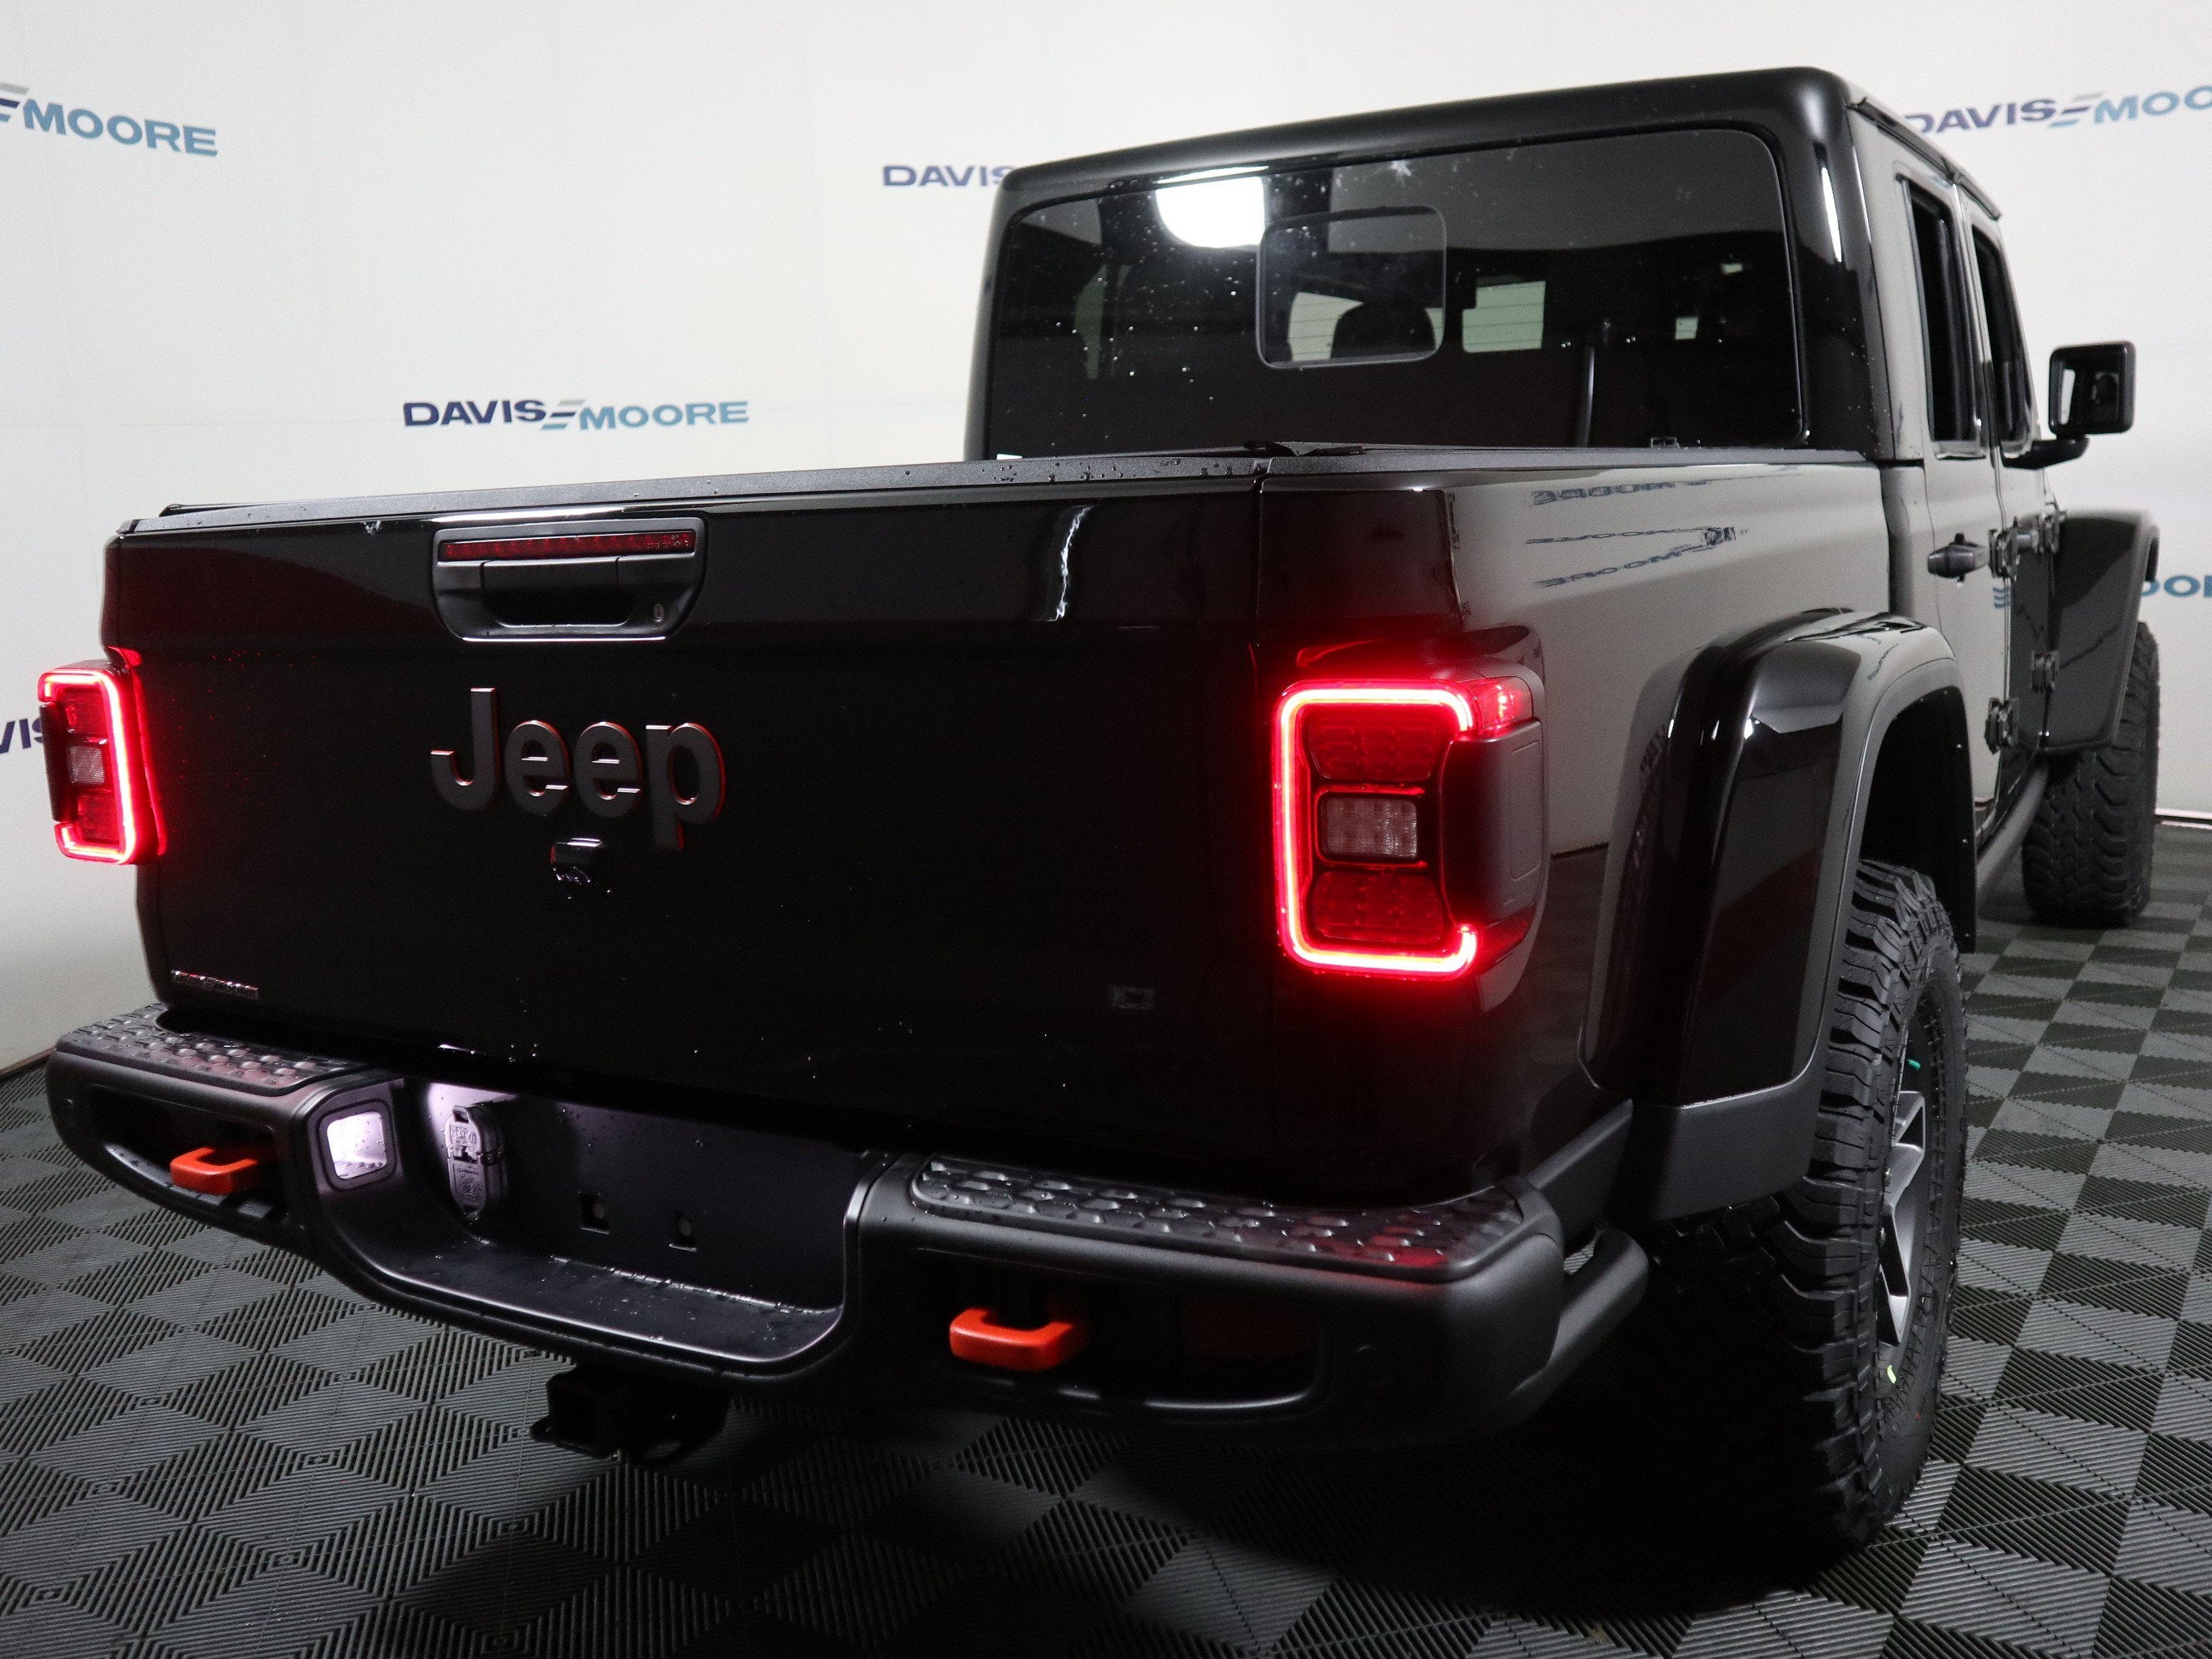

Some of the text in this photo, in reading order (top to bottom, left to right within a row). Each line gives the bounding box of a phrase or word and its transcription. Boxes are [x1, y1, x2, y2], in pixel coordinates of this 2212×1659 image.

[22, 98, 218, 157] MOORE
[402, 399, 750, 431] DAVIS MOORE
[431, 687, 727, 850] Jeep
